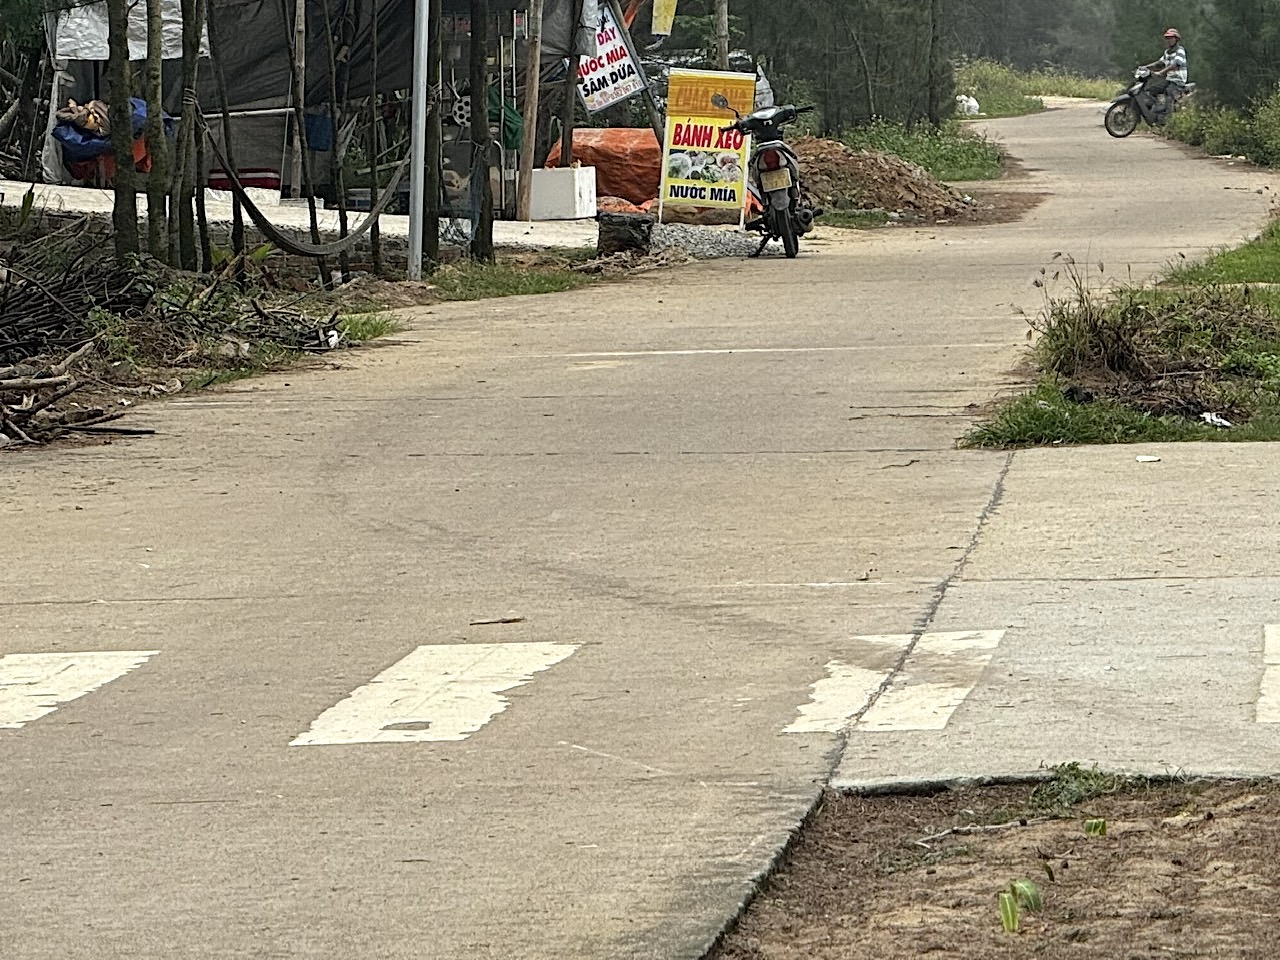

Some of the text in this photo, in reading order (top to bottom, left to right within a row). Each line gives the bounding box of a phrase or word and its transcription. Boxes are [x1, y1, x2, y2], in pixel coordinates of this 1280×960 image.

[606, 44, 628, 65] MÍA
[582, 76, 610, 98] SÂM
[672, 117, 714, 148] BÁNH
[669, 183, 737, 202] NƯỚC MÍA
